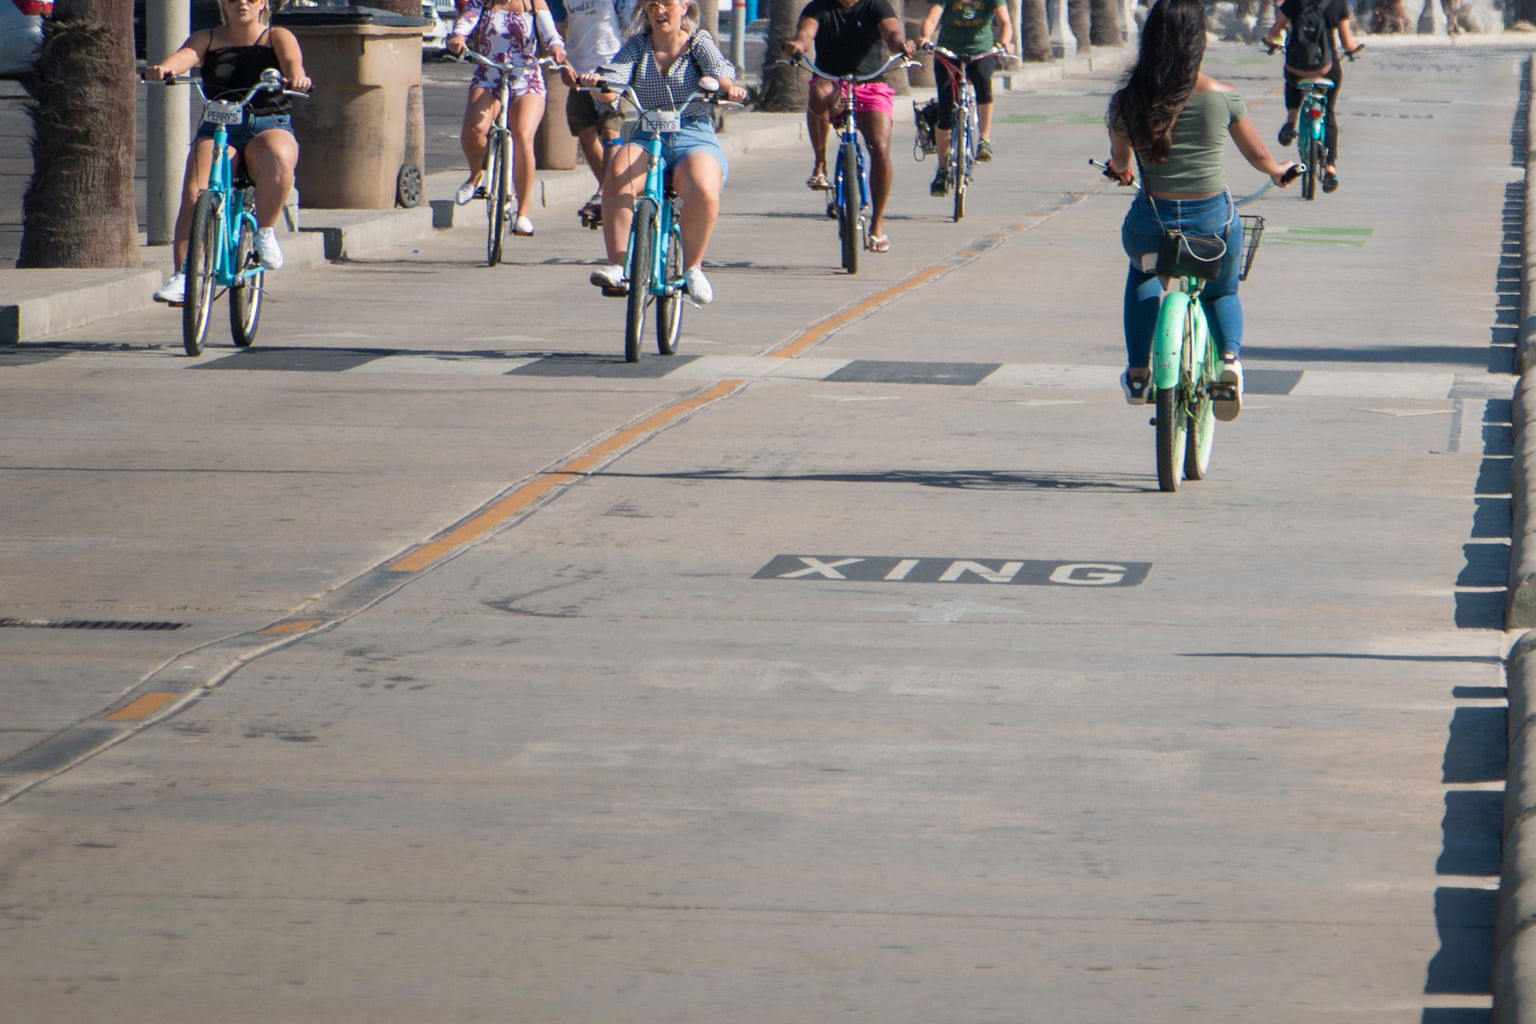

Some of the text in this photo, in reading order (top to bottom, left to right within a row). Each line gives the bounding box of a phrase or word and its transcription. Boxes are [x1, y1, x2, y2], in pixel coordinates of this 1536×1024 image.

[208, 111, 238, 122] PERRY'S
[646, 120, 677, 129] PERRY'S
[777, 556, 1128, 585] XING
